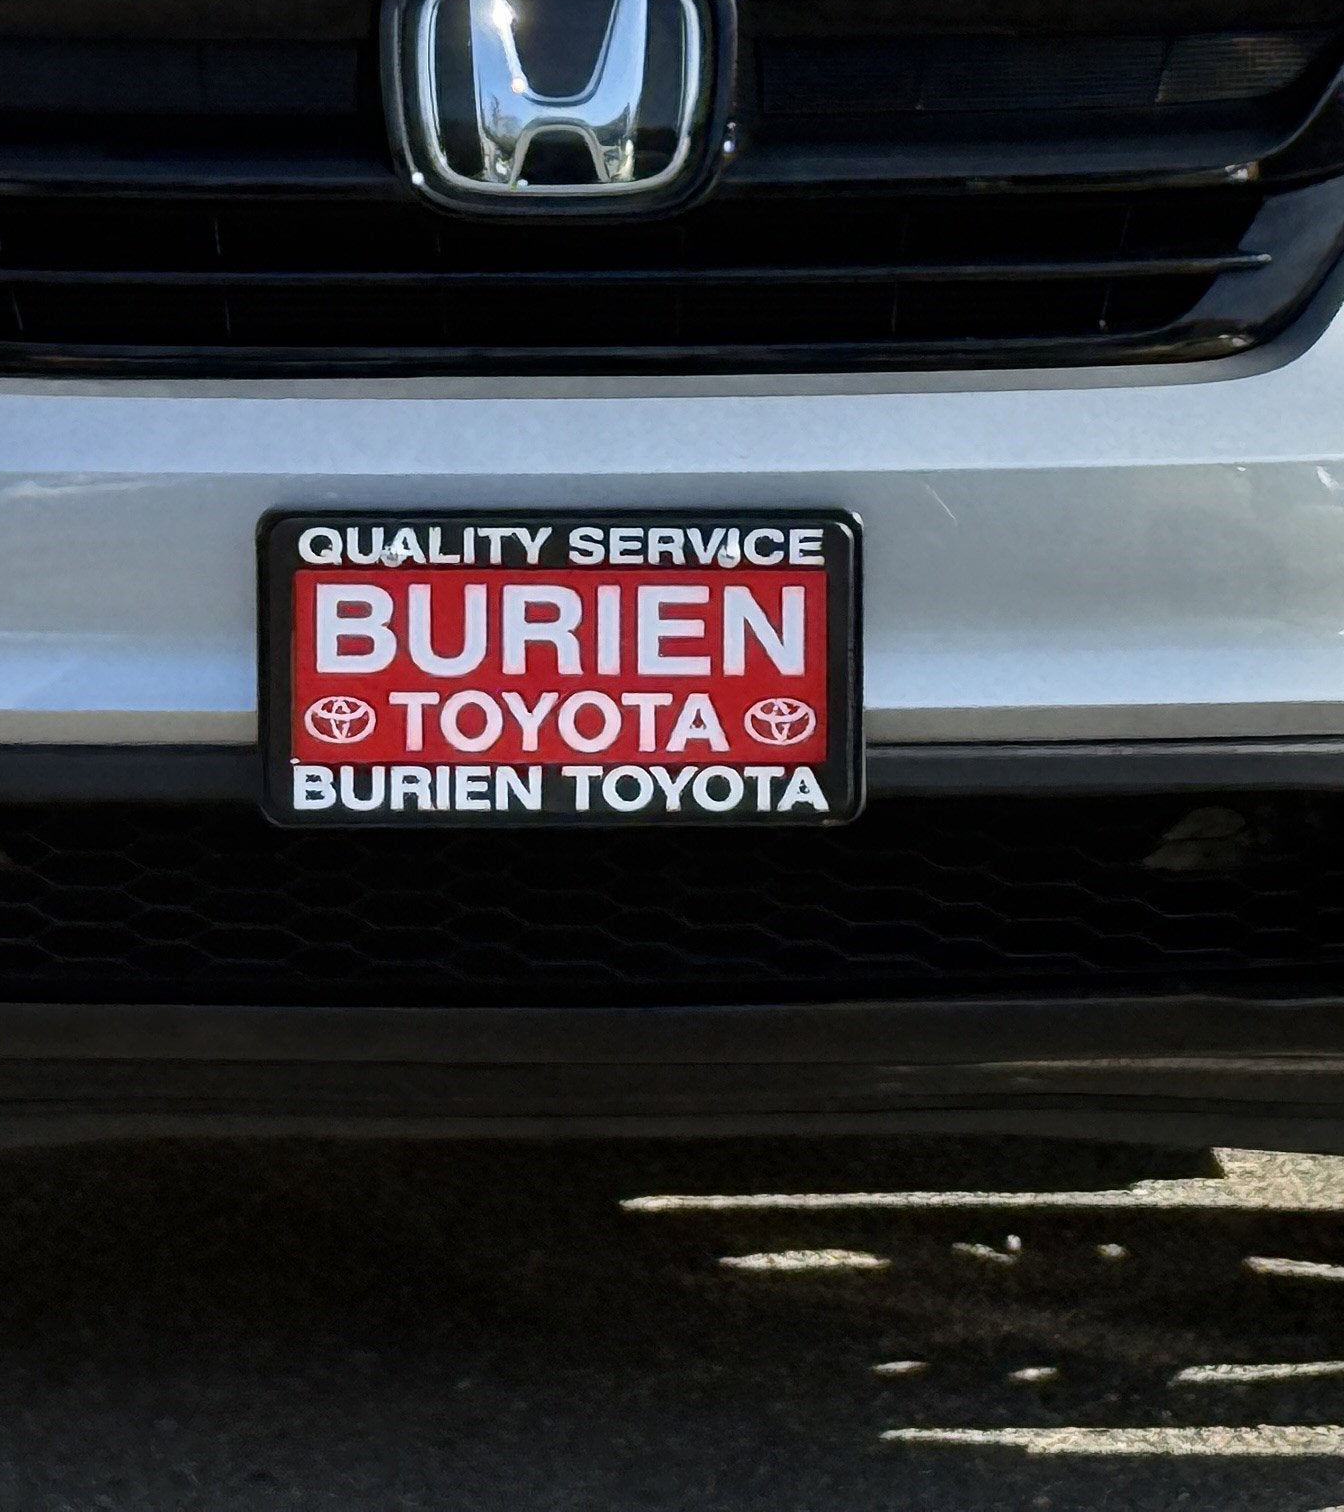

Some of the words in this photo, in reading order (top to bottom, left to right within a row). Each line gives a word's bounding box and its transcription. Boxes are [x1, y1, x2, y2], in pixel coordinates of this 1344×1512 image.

[297, 525, 553, 567] QUALITY
[568, 526, 824, 568] SERVICE
[315, 582, 807, 677] BURIEN
[388, 689, 731, 754] TOYOTA
[292, 763, 544, 812] BURIEN
[561, 764, 830, 813] TOYOTA
